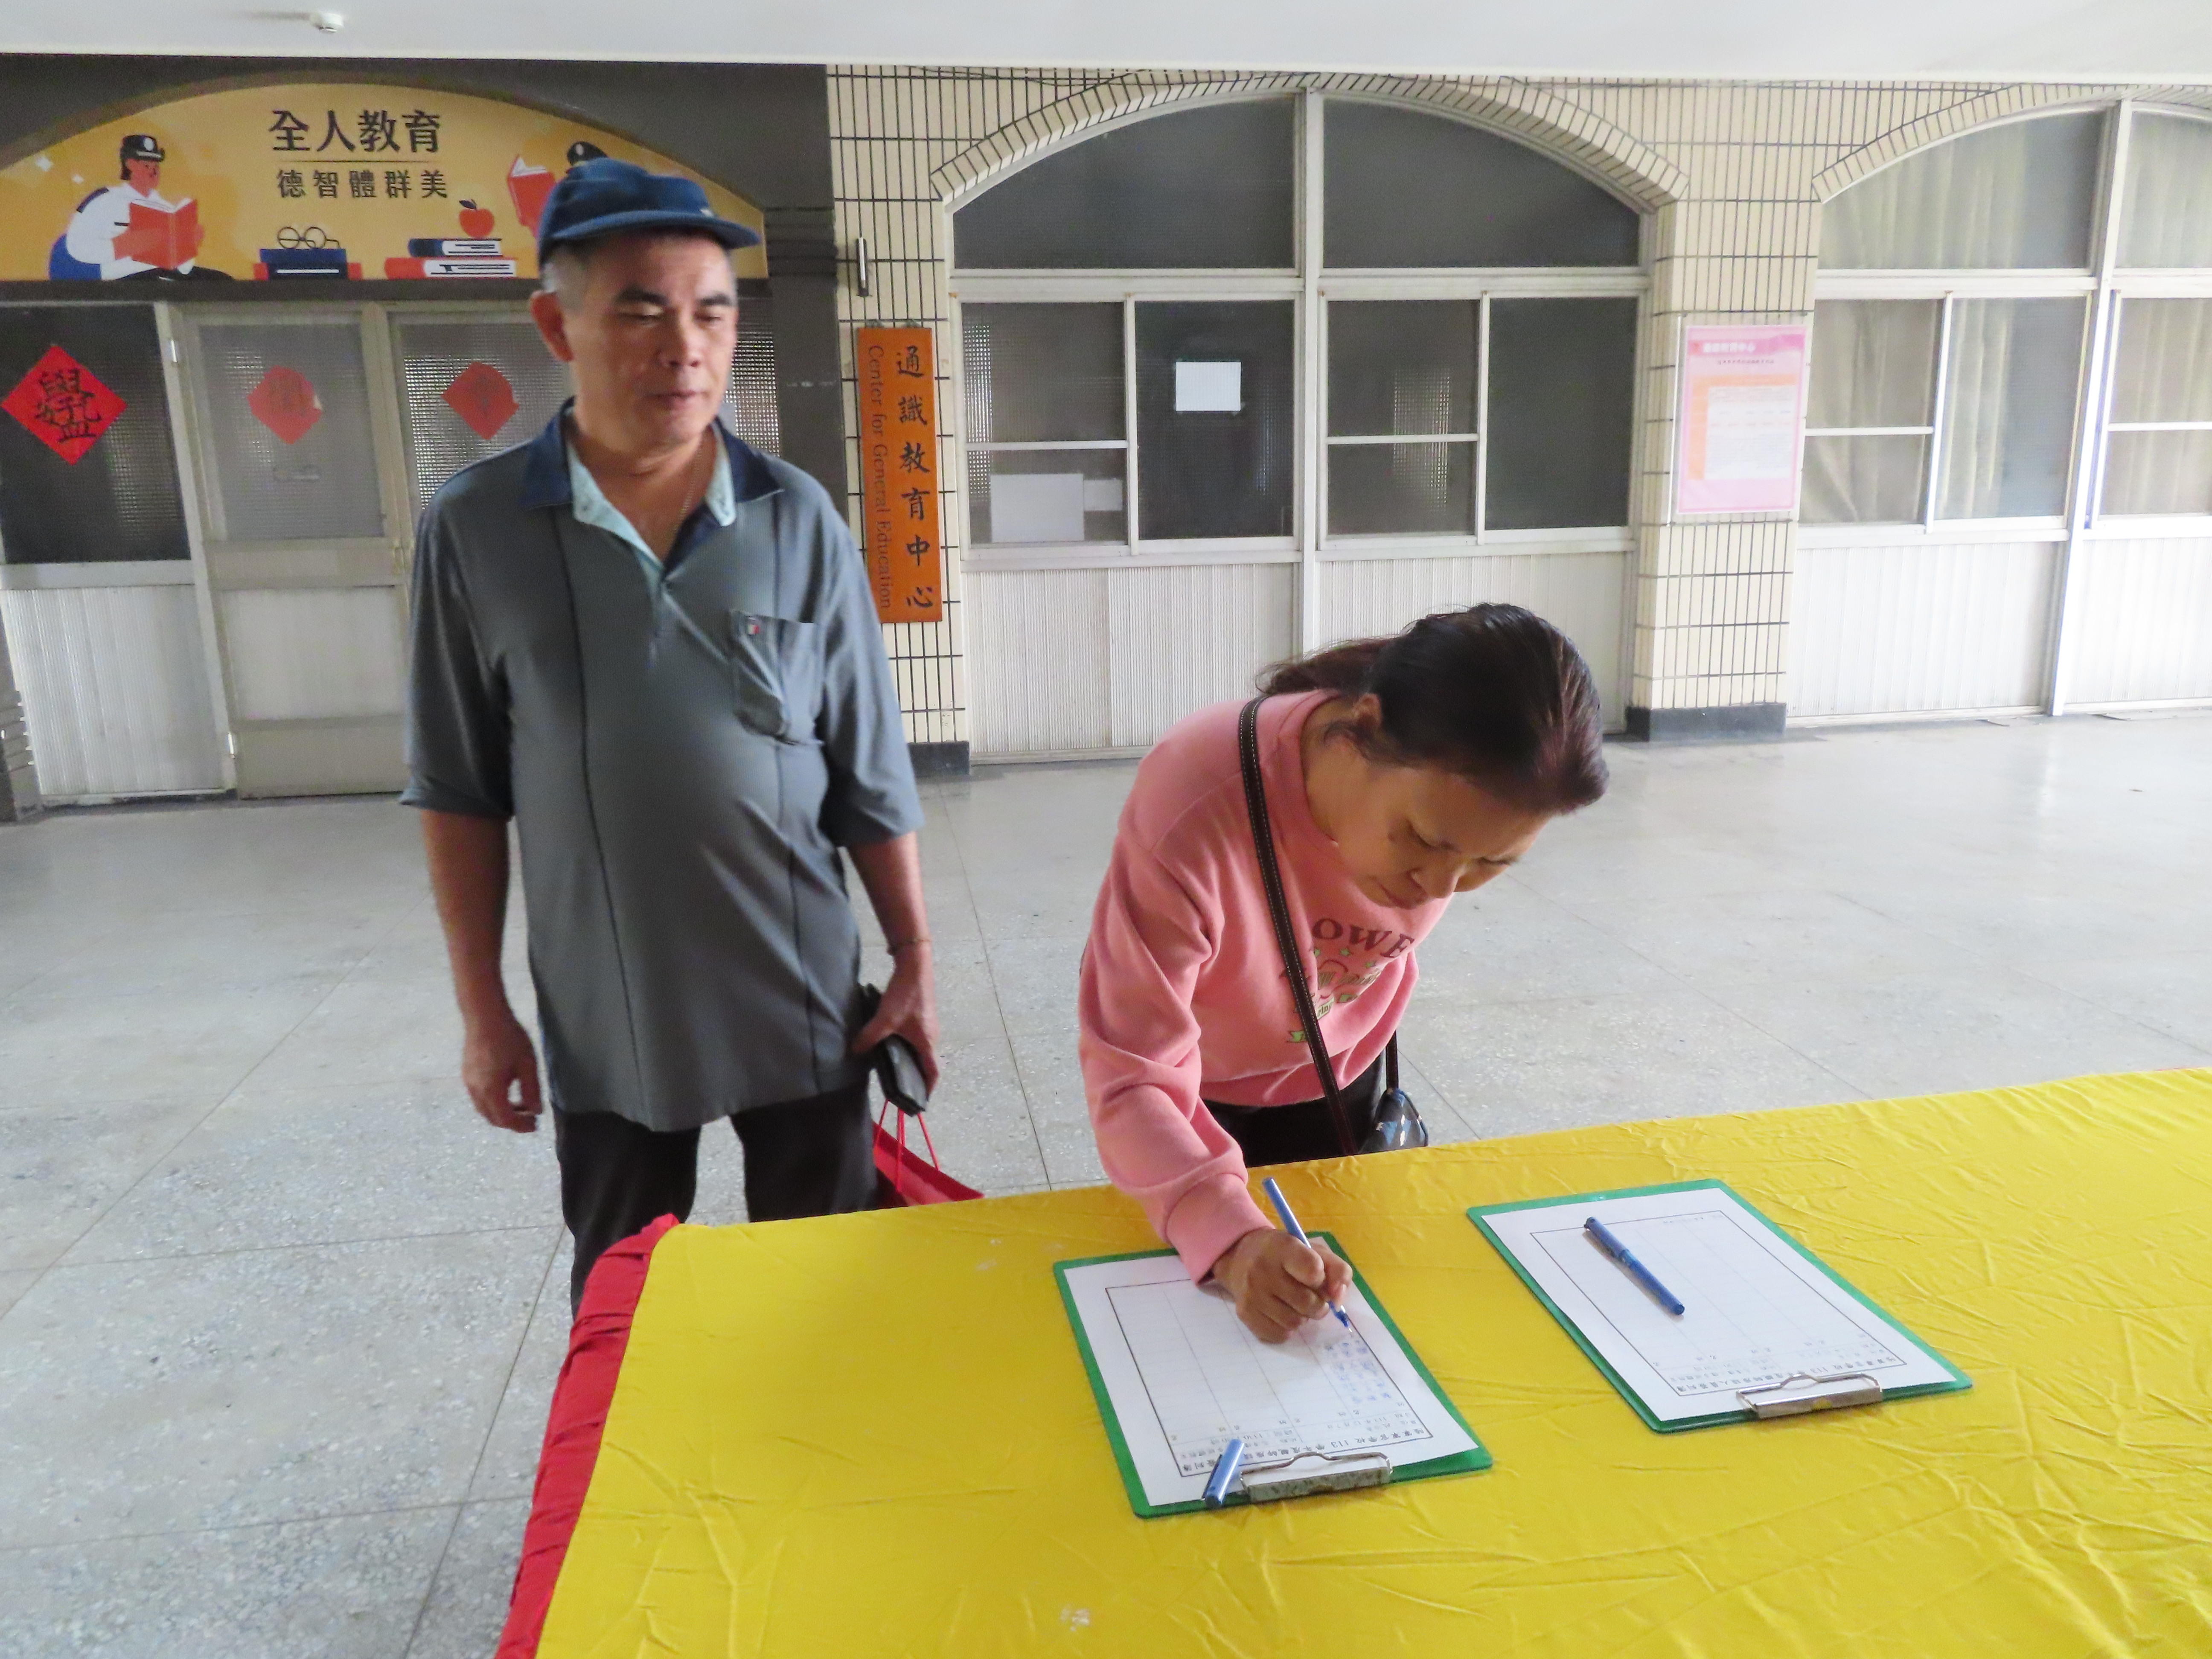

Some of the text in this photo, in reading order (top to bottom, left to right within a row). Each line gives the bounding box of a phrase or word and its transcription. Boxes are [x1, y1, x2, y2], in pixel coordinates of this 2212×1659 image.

[268, 108, 442, 153] 全人教育
[277, 169, 448, 200] 德智體群美
[868, 345, 893, 609] Center for General Education
[896, 346, 933, 608] 通識教育中心
[1312, 917, 1415, 958] OWE
